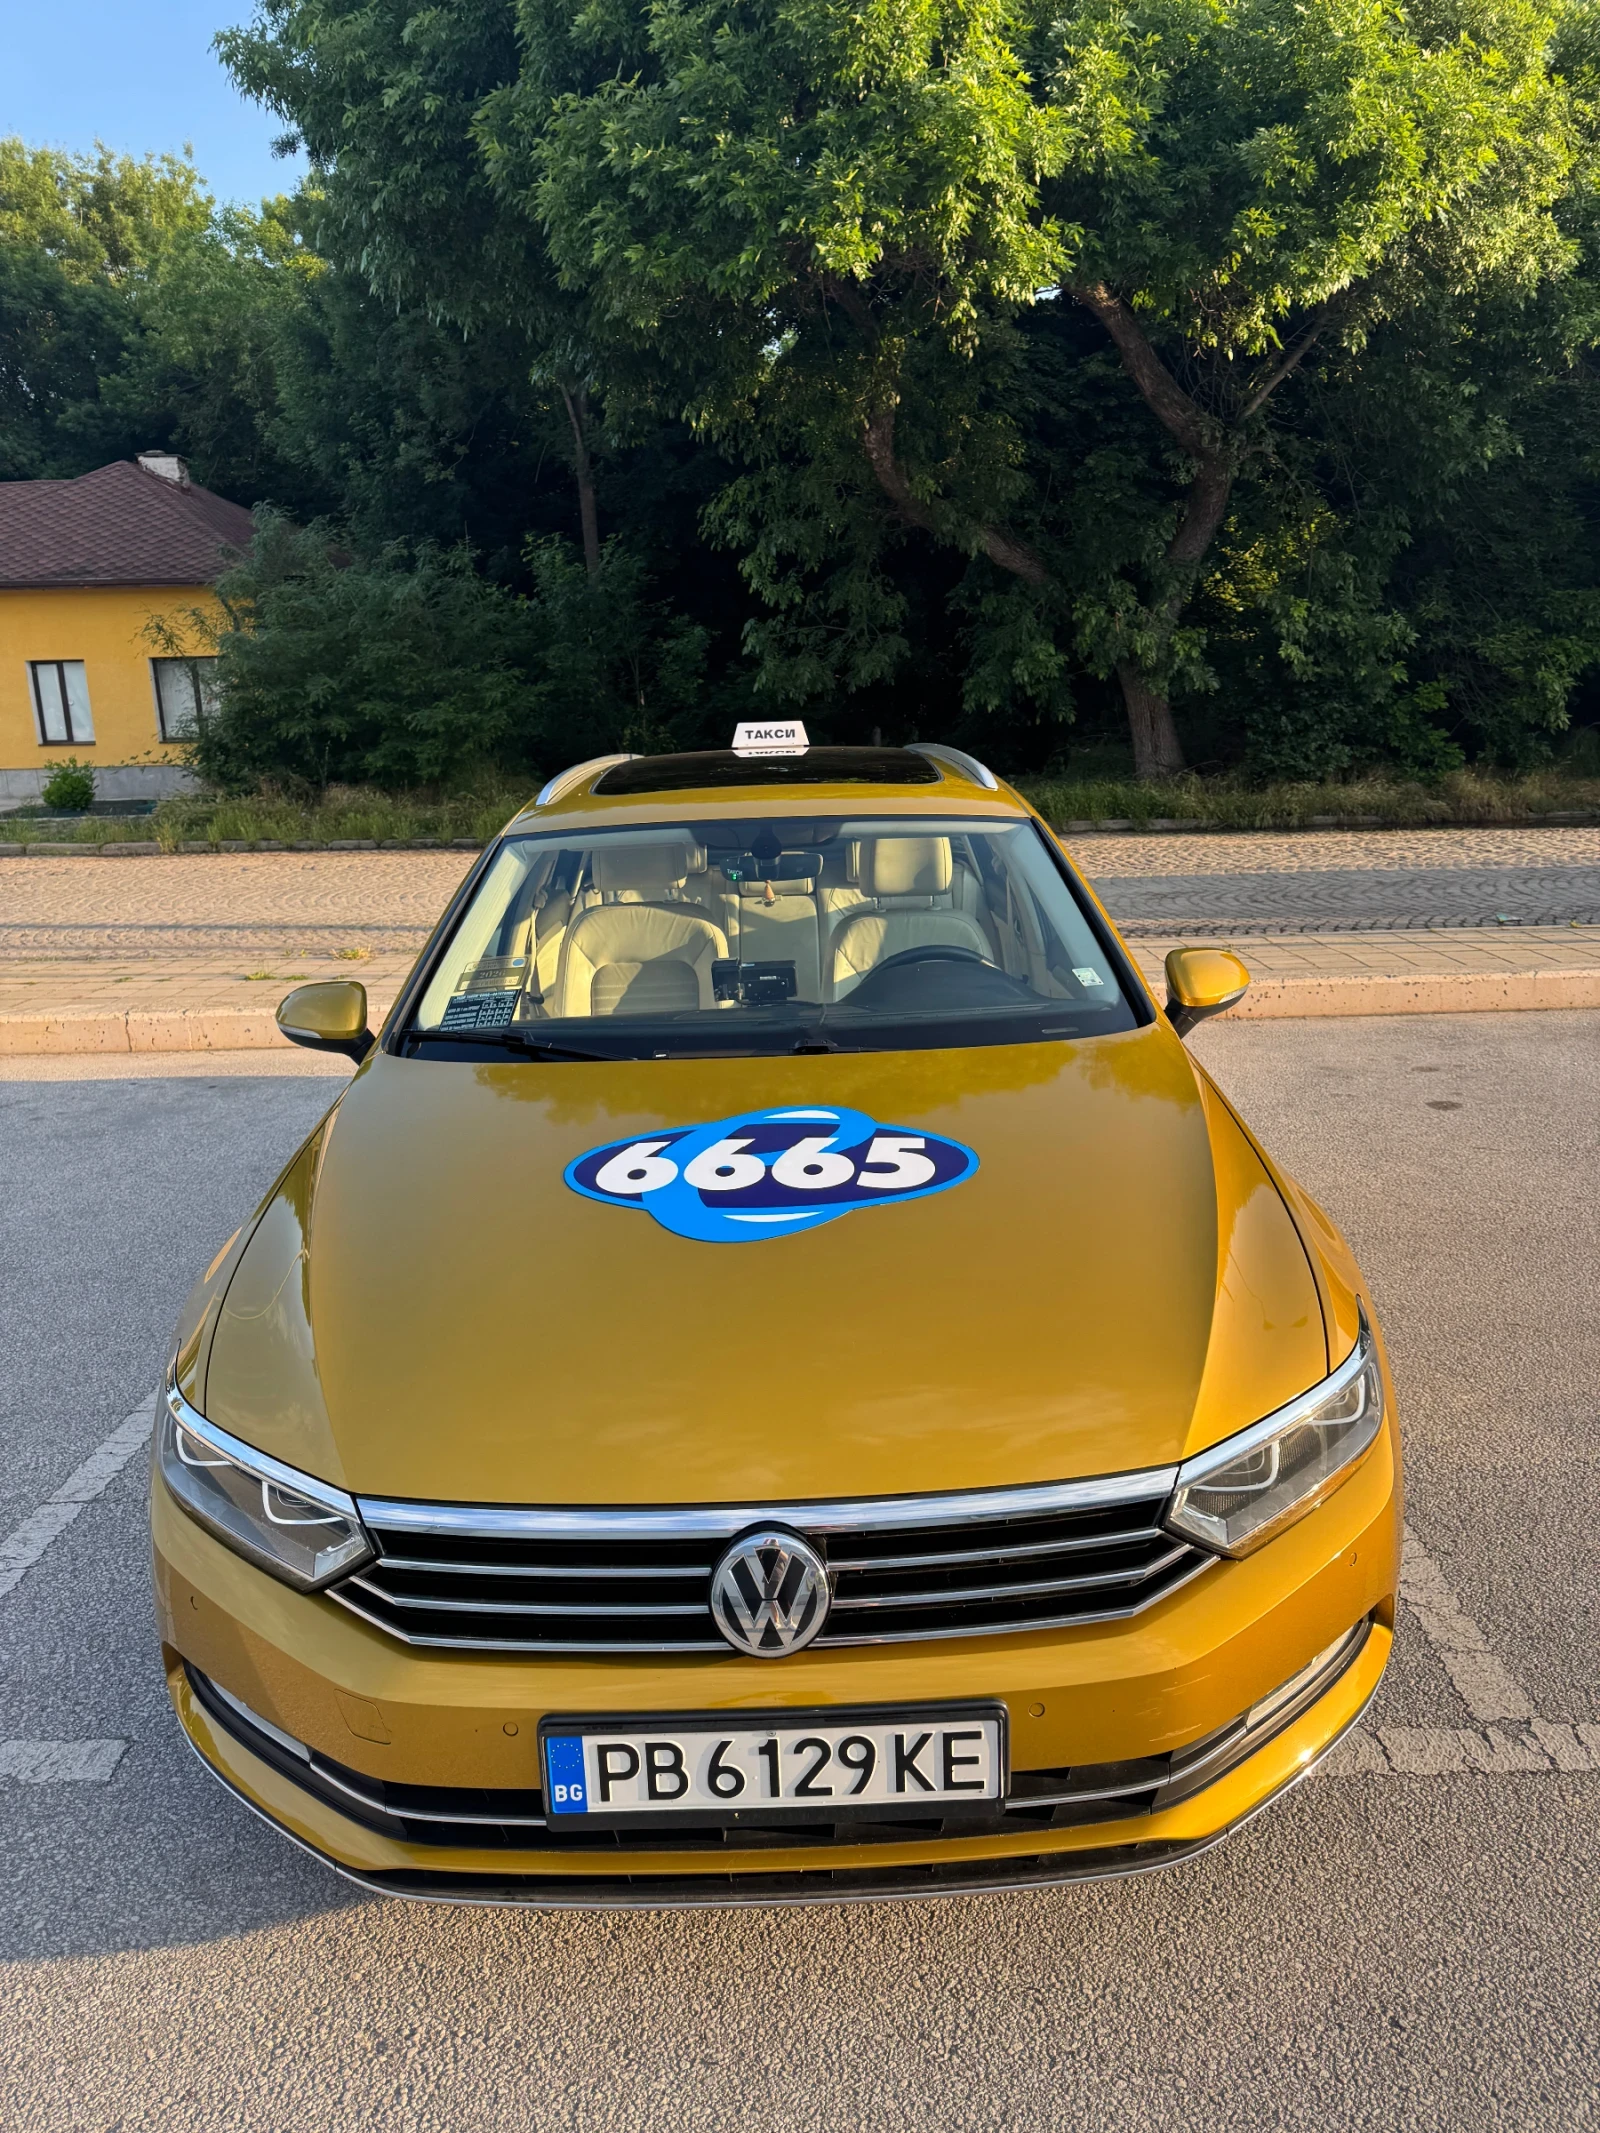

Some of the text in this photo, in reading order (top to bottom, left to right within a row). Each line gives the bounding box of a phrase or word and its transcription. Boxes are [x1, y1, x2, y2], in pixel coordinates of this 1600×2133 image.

[744, 728, 796, 740] ТАКСИ
[595, 1136, 936, 1194] 6665
[596, 1730, 986, 1802] PB 6129 KE
[554, 1784, 583, 1803] BG
